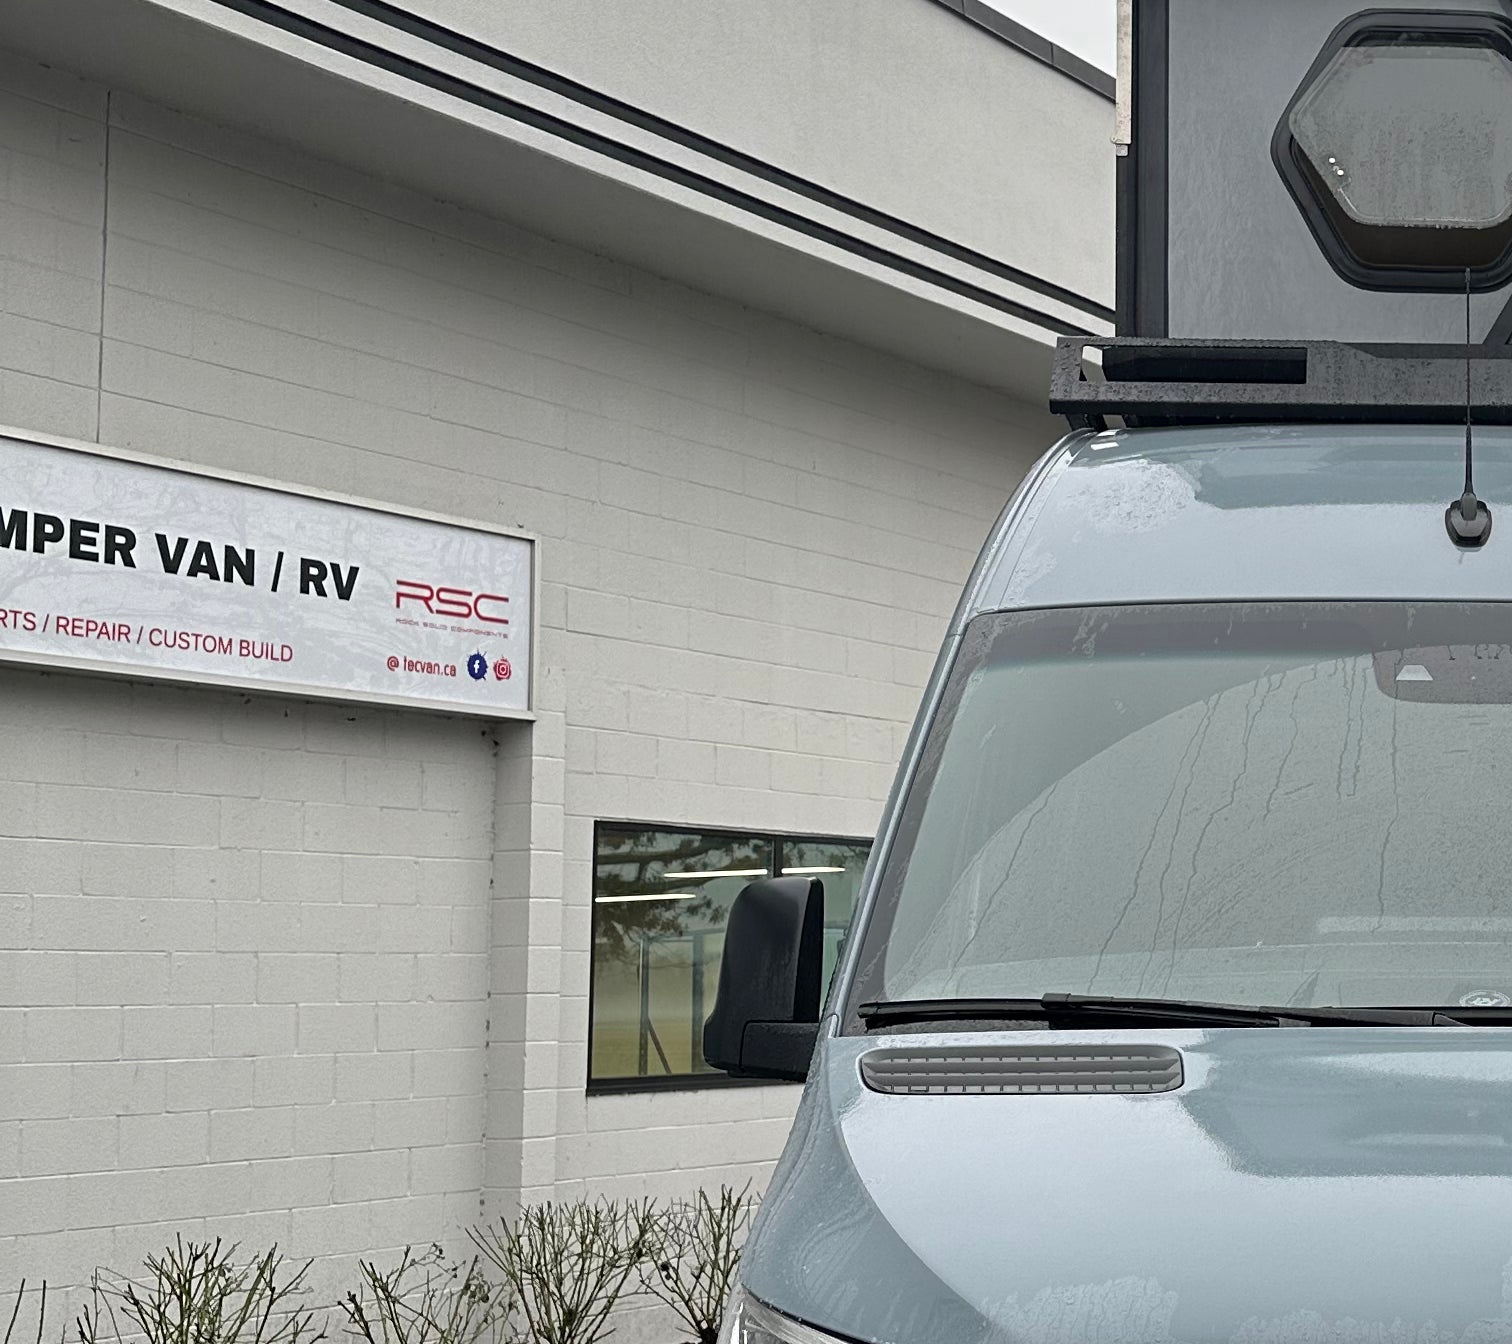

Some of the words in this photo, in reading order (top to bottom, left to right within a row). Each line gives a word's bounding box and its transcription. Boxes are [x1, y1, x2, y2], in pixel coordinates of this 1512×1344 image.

[0, 508, 137, 569] MPER
[154, 533, 255, 587] VAN
[271, 551, 284, 593] /
[299, 557, 360, 601] RV
[396, 579, 509, 625] RSC
[55, 616, 131, 643] REPAIR
[149, 628, 233, 656] CUSTOM
[239, 639, 293, 663] BUILD
